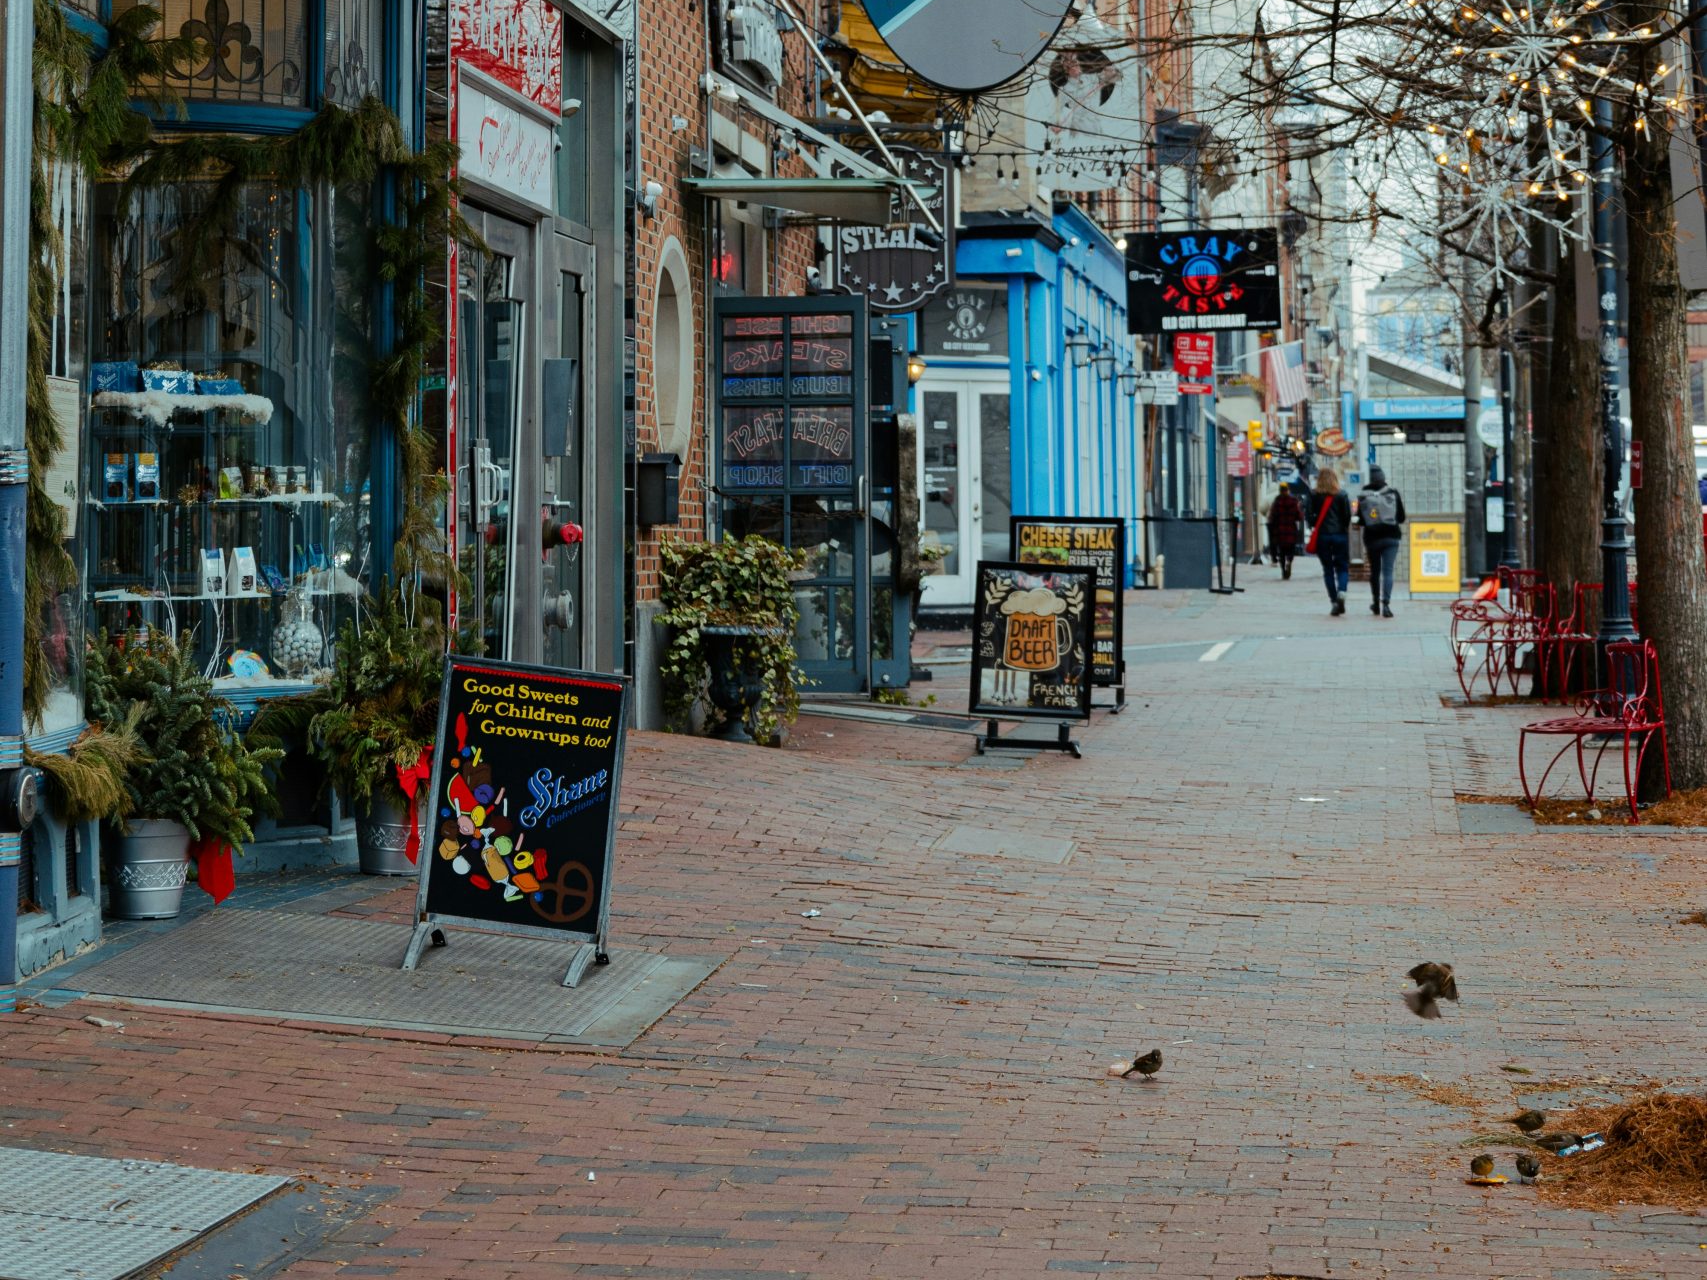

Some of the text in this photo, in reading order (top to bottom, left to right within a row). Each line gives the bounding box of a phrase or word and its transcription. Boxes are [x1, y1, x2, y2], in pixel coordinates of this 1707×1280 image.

[841, 223, 942, 254] STEAK
[1160, 236, 1243, 265] CRAY
[1162, 282, 1244, 313] TASTE
[947, 320, 985, 339] TASTE
[1021, 525, 1115, 550] CHEESE STEAK
[1068, 555, 1113, 567] RIBEYE
[1011, 619, 1055, 639] DRAFT
[1009, 639, 1055, 665] BEER
[1097, 641, 1113, 652] BAR
[463, 678, 579, 706] Good Sweets
[1033, 683, 1078, 697] FRENCH
[1044, 696, 1079, 707] FRIES
[468, 698, 612, 729] for Children and
[480, 719, 612, 748] Grown-ups too!
[520, 767, 608, 828] Shane
